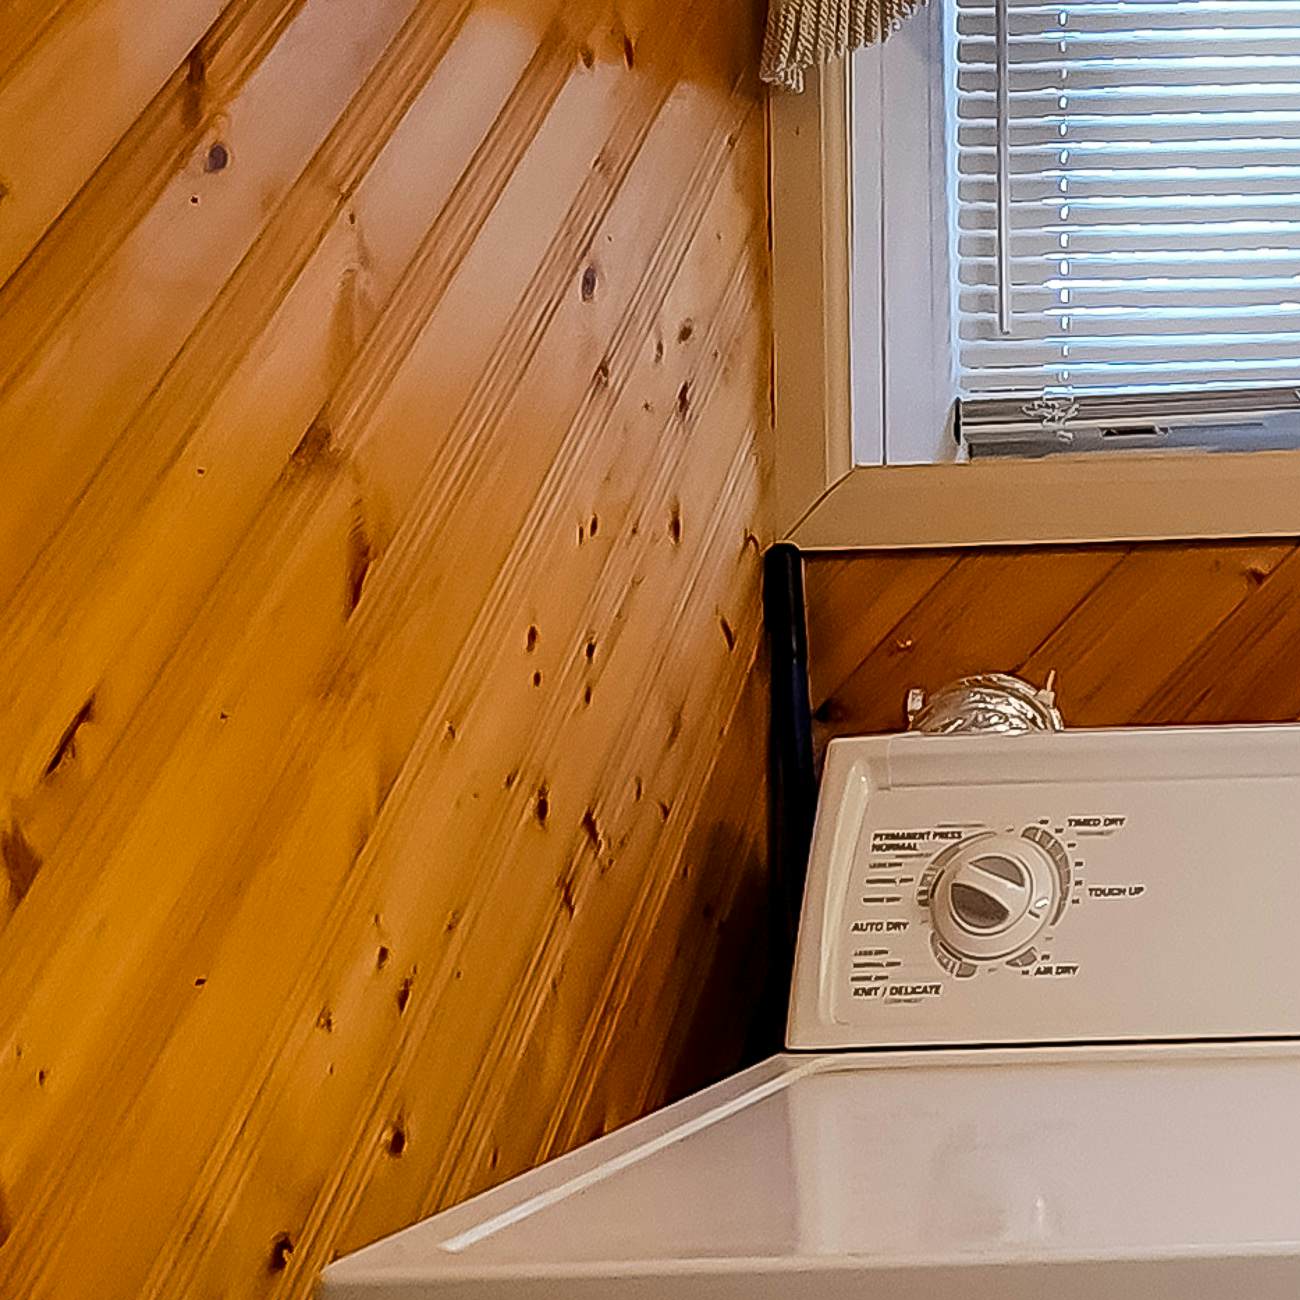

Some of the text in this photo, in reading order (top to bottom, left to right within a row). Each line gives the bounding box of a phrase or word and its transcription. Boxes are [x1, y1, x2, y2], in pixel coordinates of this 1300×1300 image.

[1067, 817, 1126, 827] TIMED DRY
[872, 830, 963, 841] PERMANENT PRESS
[871, 842, 918, 852] NORMAL
[1088, 886, 1145, 897] TOUCH UP
[851, 921, 909, 932] AUTO DRY
[1034, 966, 1079, 976] AIR DRY
[889, 985, 941, 996] DELICATE
